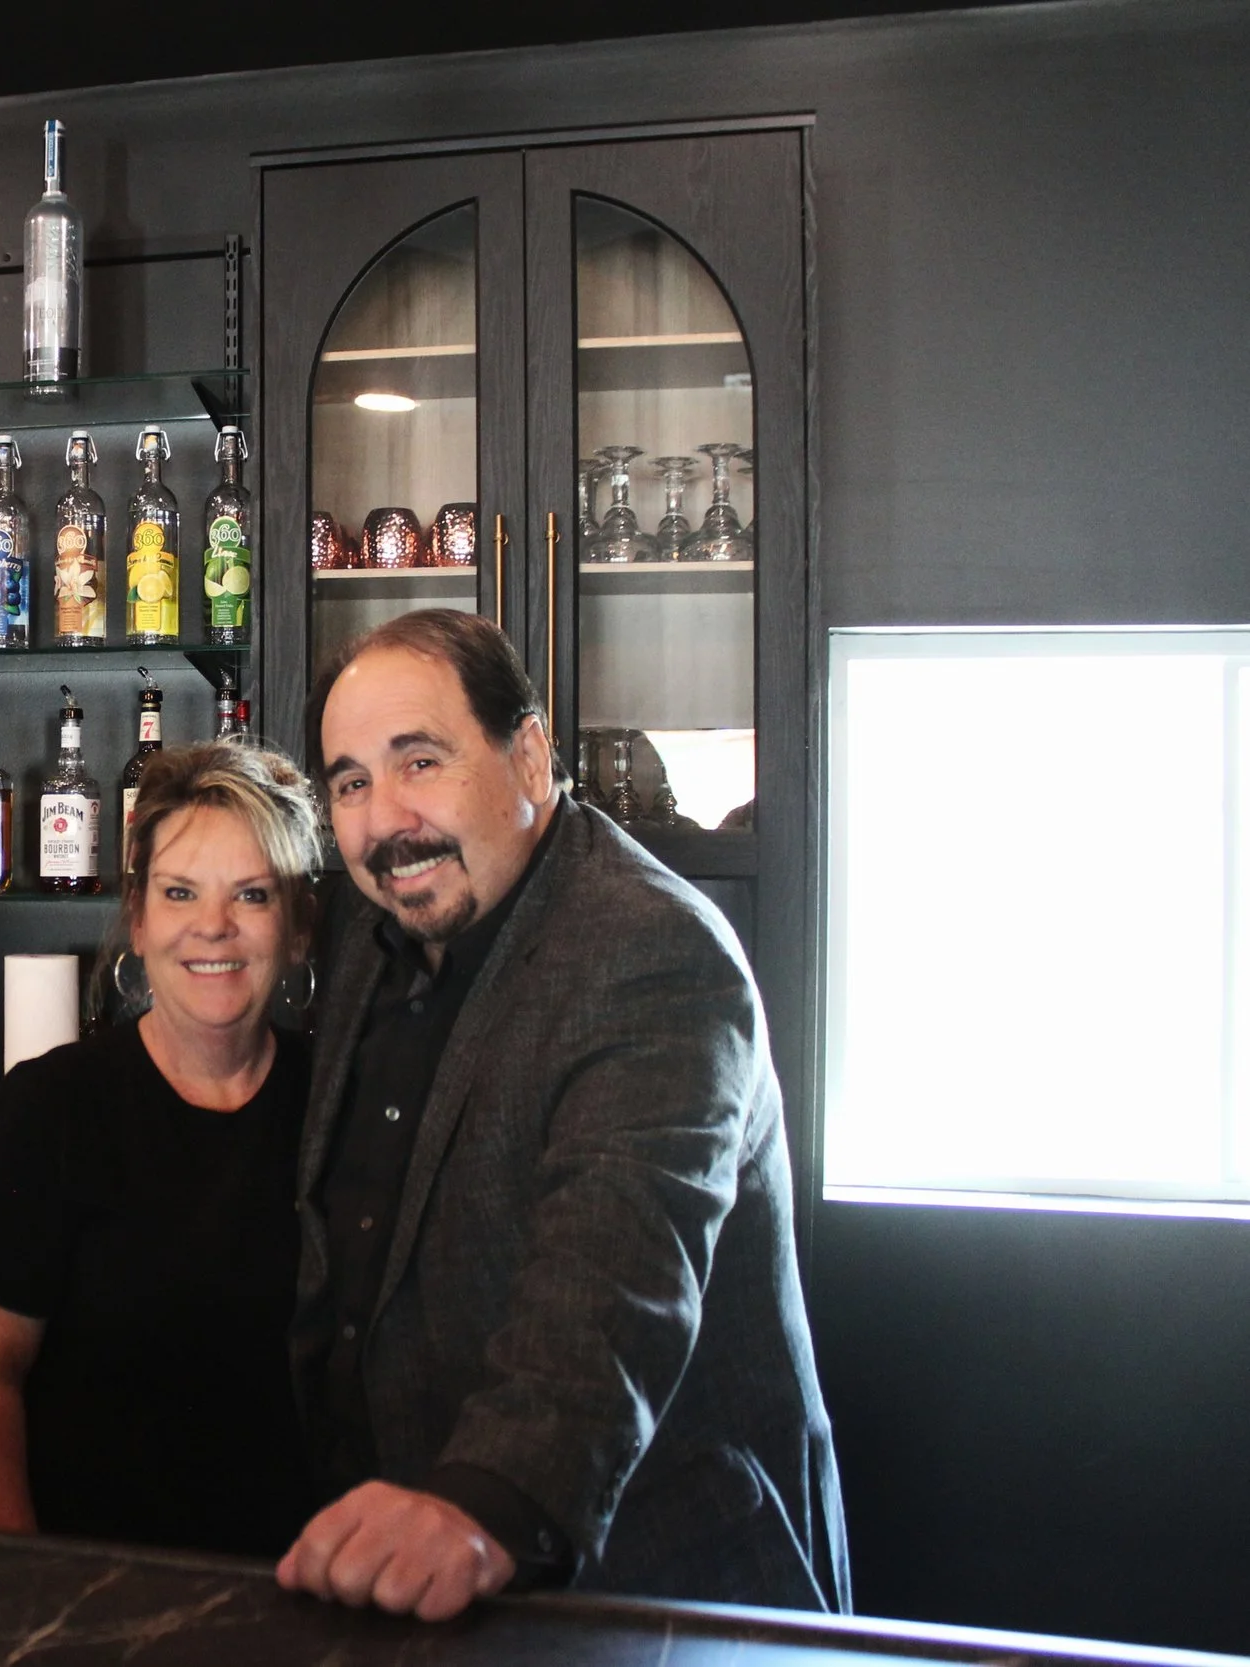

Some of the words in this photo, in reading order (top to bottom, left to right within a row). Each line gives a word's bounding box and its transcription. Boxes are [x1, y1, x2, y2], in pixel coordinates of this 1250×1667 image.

[58, 531, 85, 552] 360
[134, 529, 165, 551] 360
[210, 524, 241, 547] 360
[142, 721, 155, 739] 7
[42, 804, 57, 822] JIM
[57, 801, 84, 821] BEAM
[43, 843, 80, 854] BOURBON
